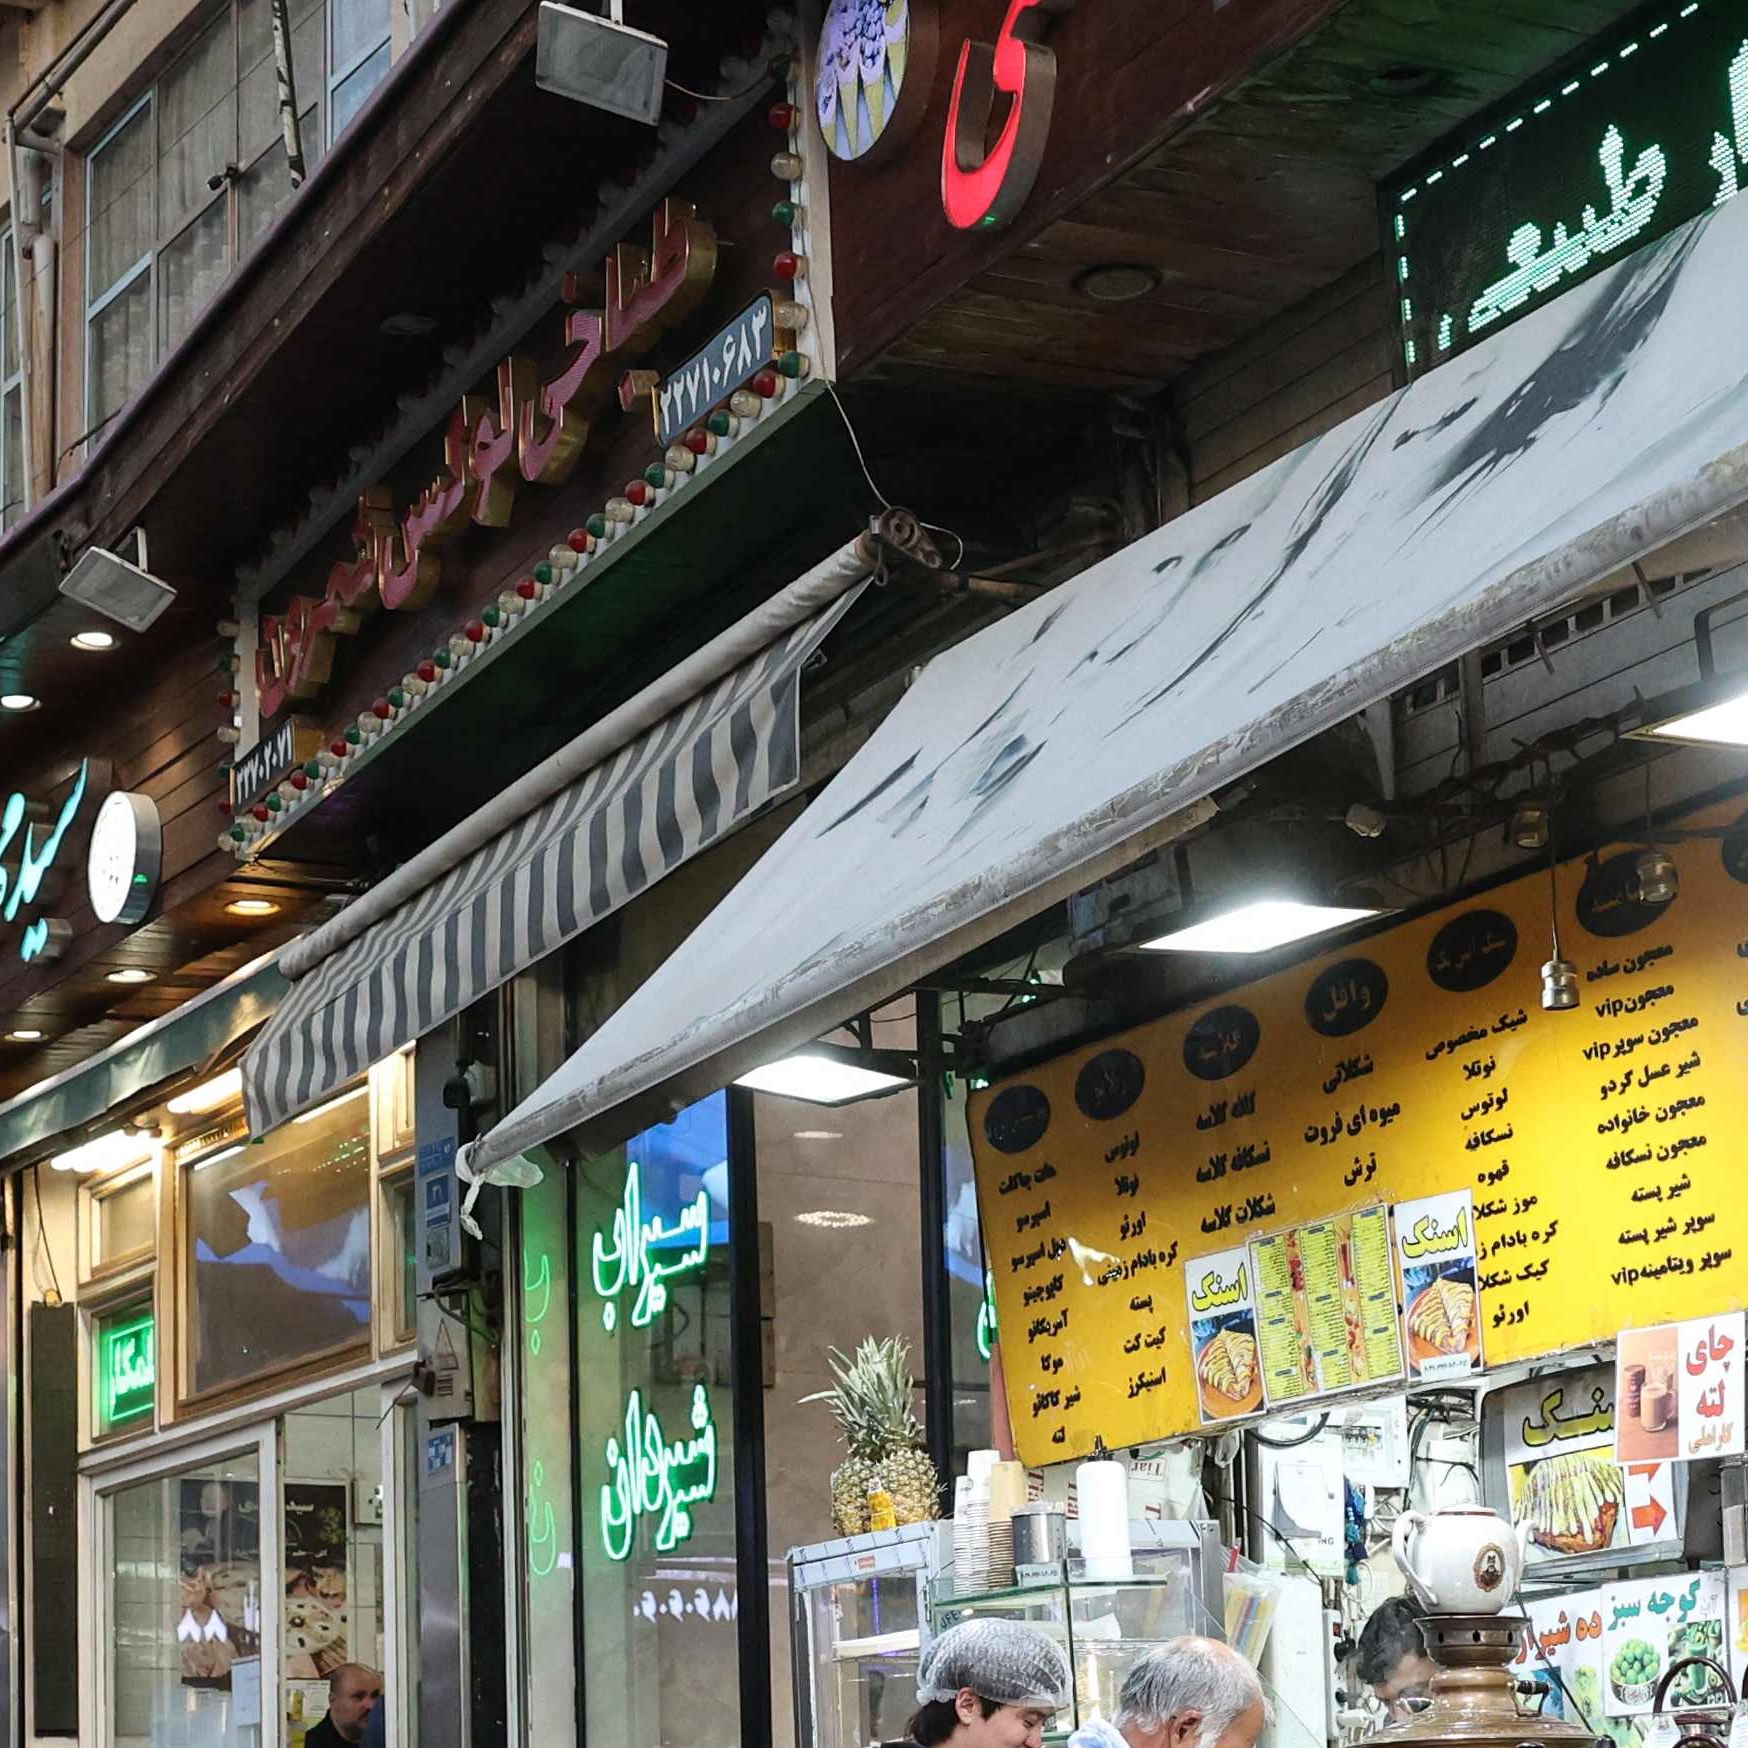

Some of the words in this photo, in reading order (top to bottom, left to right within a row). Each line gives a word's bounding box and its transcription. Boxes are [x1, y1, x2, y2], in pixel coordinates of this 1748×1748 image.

[660, 302, 770, 437] ۲۲۷۱۰۶۸۳
[1586, 962, 1620, 982] ساده
[1623, 944, 1673, 974] معجون
[1492, 1009, 1528, 1036] شیک
[1648, 1016, 1699, 1045] معجون
[1425, 1024, 1488, 1061] مخصوص
[1583, 1041, 1610, 1061] vip
[1614, 1034, 1644, 1057] سوپر
[1323, 1054, 1375, 1095] شکلاتی
[1637, 1063, 1670, 1088] عسل
[1675, 1052, 1701, 1078] شیر
[1600, 1070, 1633, 1100] گردو
[1368, 1099, 1401, 1124] میوه
[1460, 1088, 1509, 1121] لوتوس
[1655, 1096, 1705, 1122] معجون
[1303, 1111, 1344, 1146] فروت
[1597, 1107, 1650, 1134] خانواده
[1464, 1123, 1514, 1151] نسکافه
[1657, 1135, 1707, 1162] معجون
[1343, 1152, 1378, 1188] ترش
[1606, 1144, 1652, 1170] نسکافه
[1477, 1160, 1510, 1185] قهوه
[1667, 1173, 1691, 1199] شیر
[1512, 1195, 1538, 1215] موز
[1631, 1185, 1662, 1202] پسته
[1473, 1200, 1509, 1222] شکلا
[1682, 1212, 1715, 1235] سوپر
[1402, 1206, 1468, 1258] اسنک
[1619, 1227, 1649, 1247] پسته
[1654, 1217, 1677, 1242] شیر
[592, 1162, 708, 1331] سیراب
[1701, 1248, 1732, 1270] سوپر
[1192, 1261, 1248, 1312] اسنک
[1479, 1268, 1514, 1292] شکلا
[1515, 1259, 1550, 1287] کیک
[1492, 1301, 1530, 1328] اورئو
[1685, 1324, 1735, 1377] چای
[1696, 1378, 1726, 1418] لته
[600, 1385, 715, 1561] شیردان
[1607, 1595, 1642, 1631] سبز
[1647, 1578, 1701, 1623] گوجه
